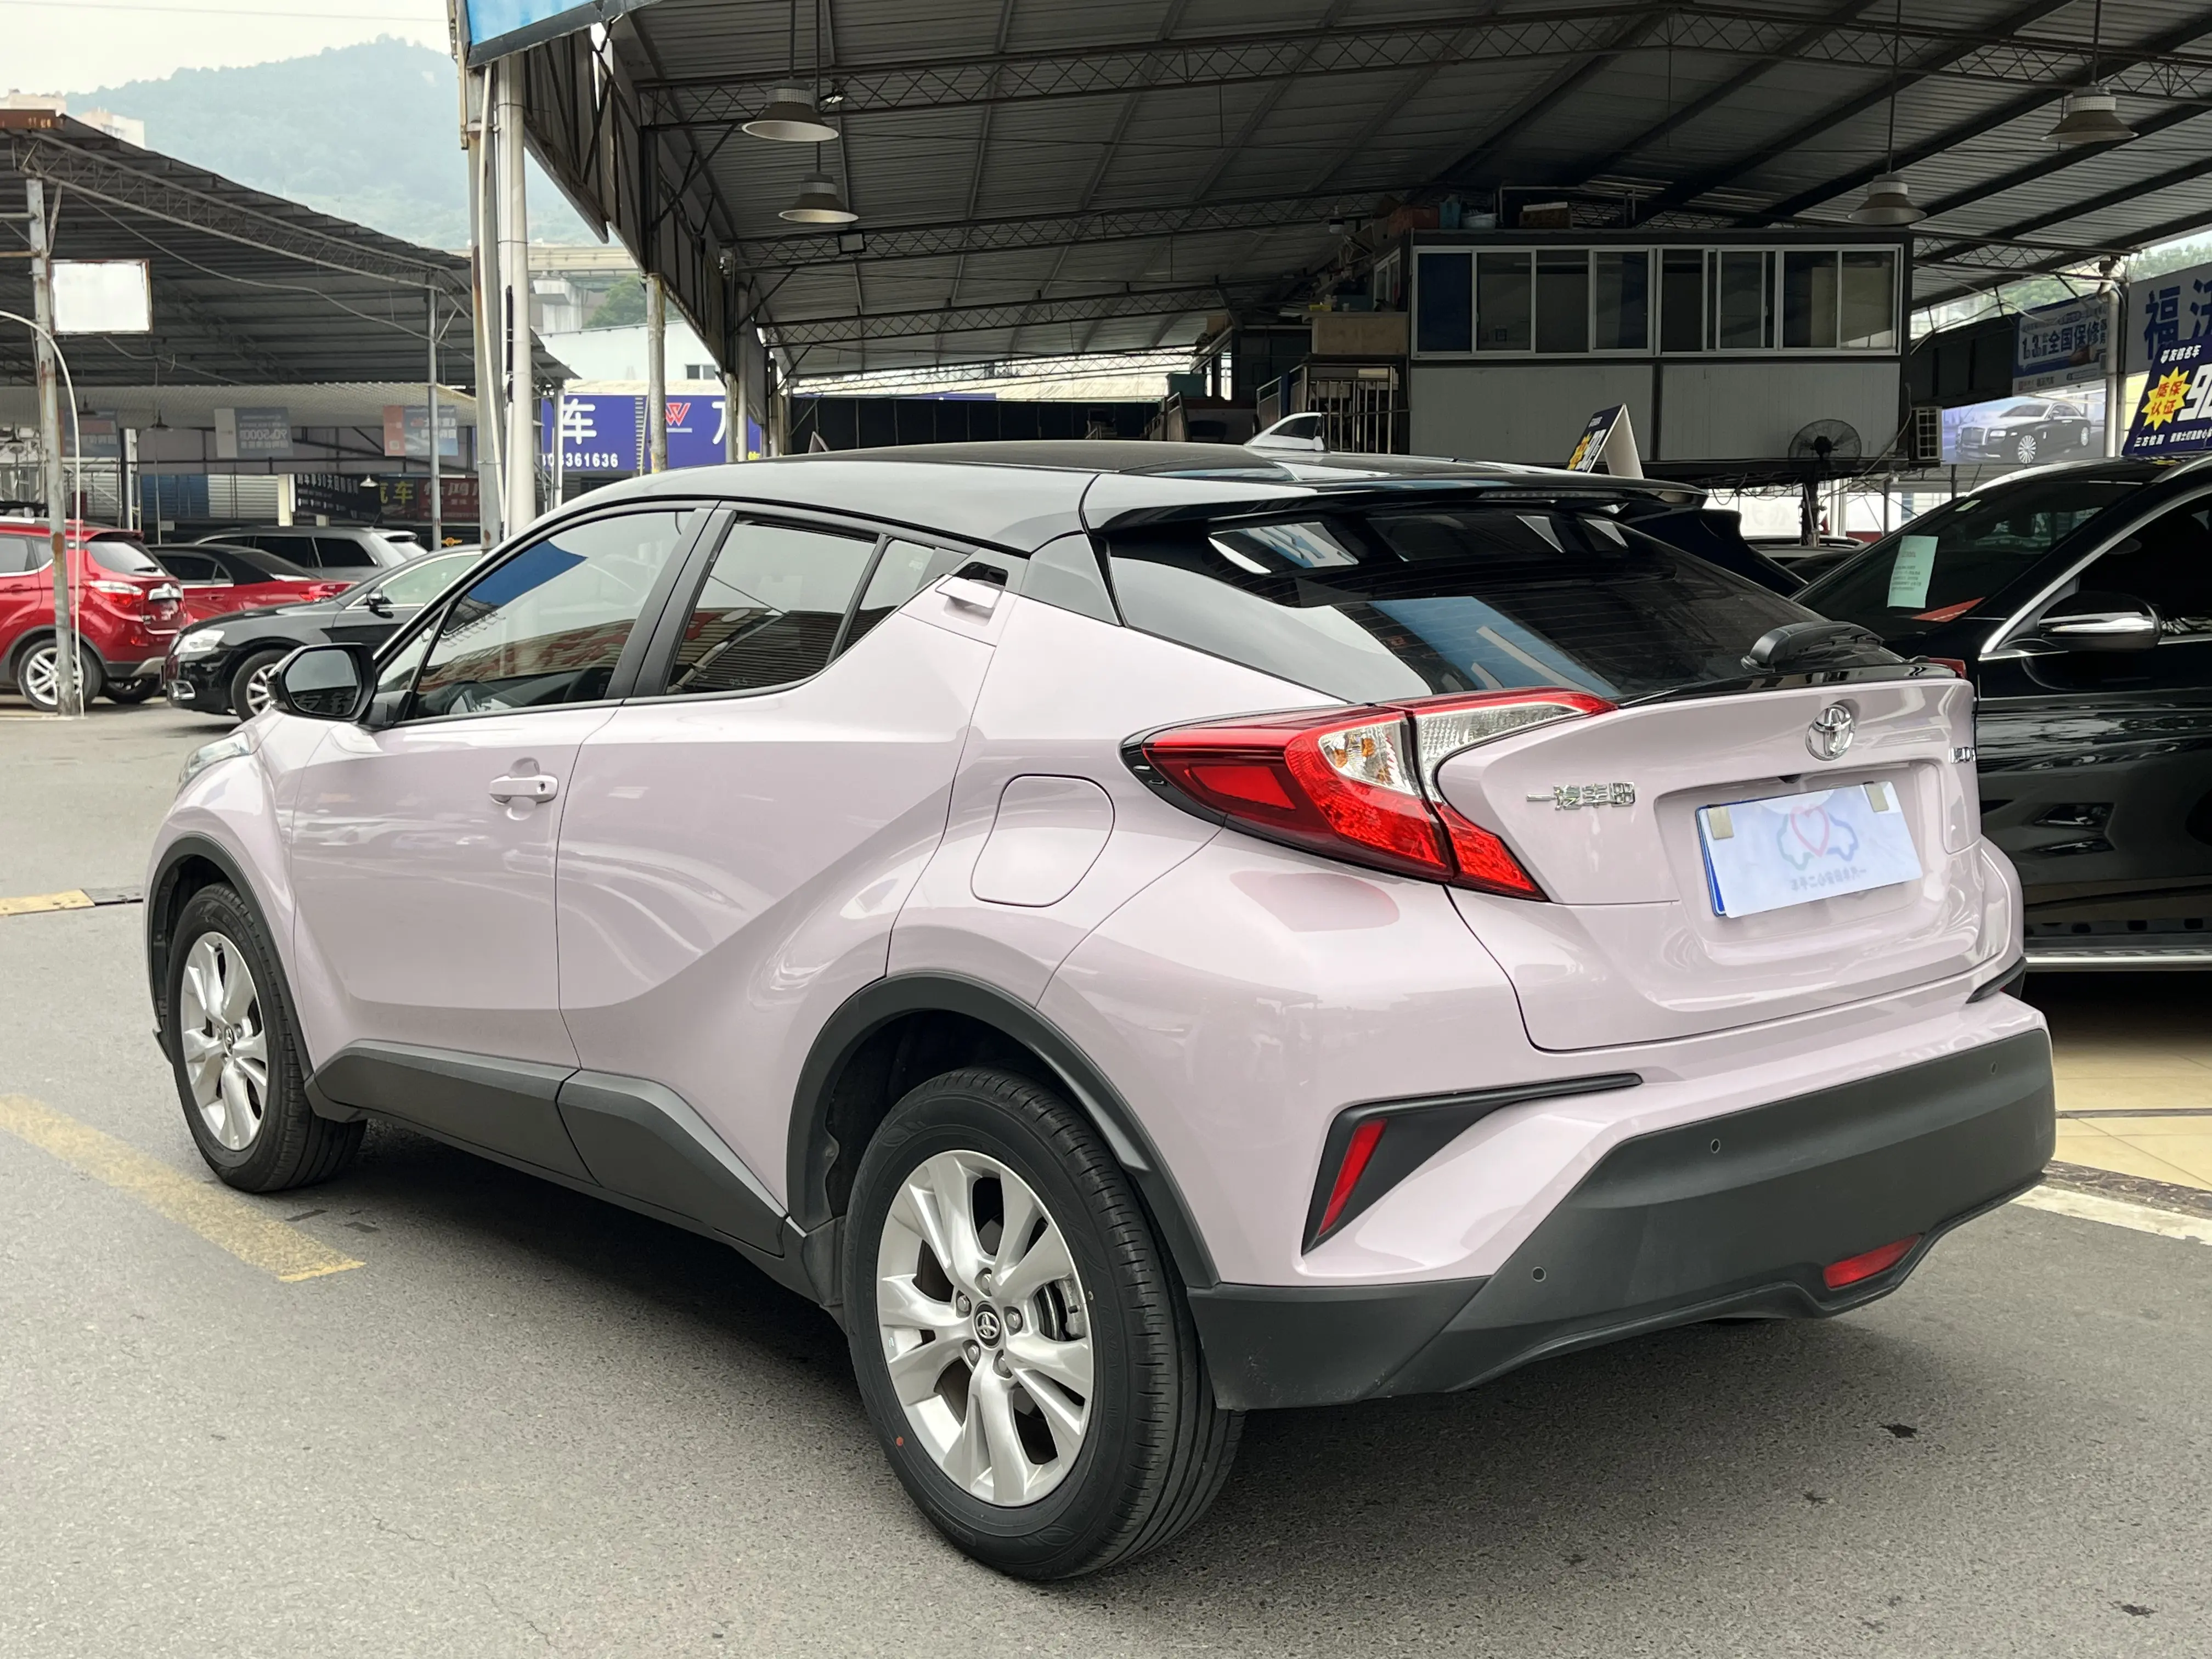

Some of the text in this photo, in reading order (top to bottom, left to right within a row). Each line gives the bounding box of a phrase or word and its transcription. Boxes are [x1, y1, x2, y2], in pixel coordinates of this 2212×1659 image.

[2156, 380, 2183, 398] 质保
[2150, 399, 2176, 415] 认证
[1526, 781, 1636, 811] 一汽丰田
